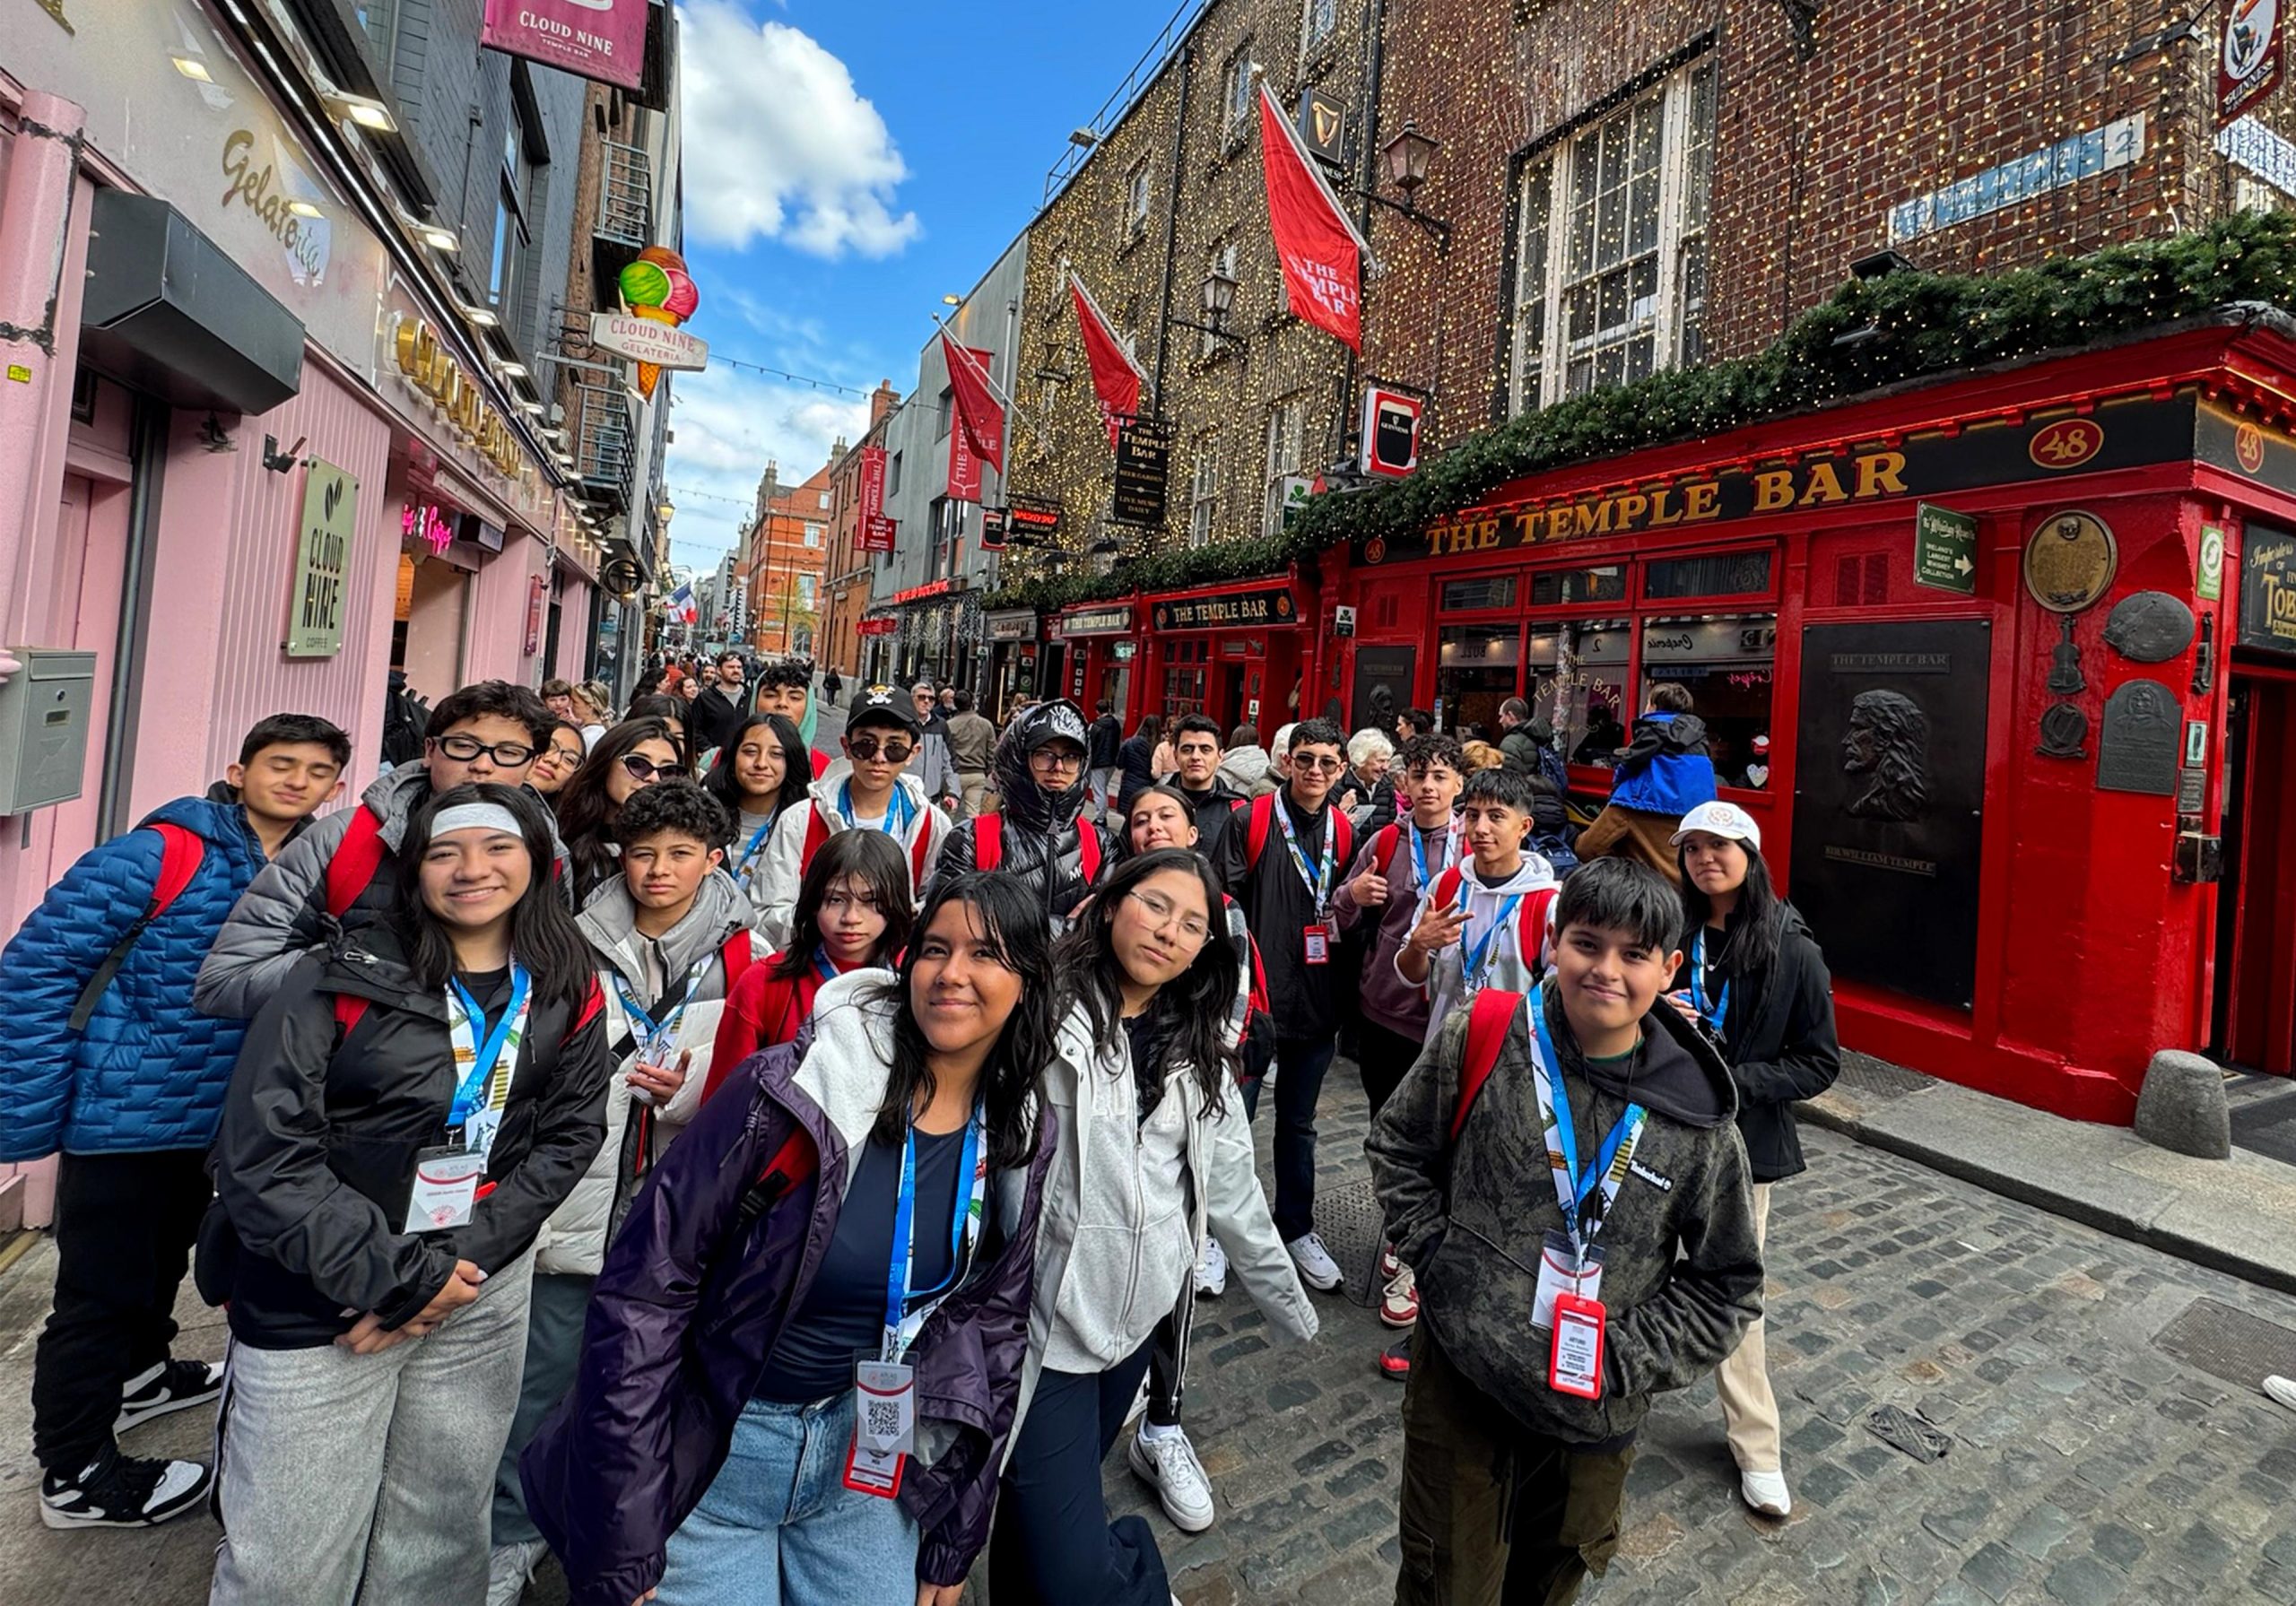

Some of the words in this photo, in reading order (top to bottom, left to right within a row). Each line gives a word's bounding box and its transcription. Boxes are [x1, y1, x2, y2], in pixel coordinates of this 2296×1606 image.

[519, 10, 571, 38] CLOUD
[577, 31, 613, 56] NINE
[542, 39, 571, 54] TEMPLE
[574, 50, 589, 58] BAR
[2115, 131, 2134, 155] 2
[1302, 258, 1338, 280] THE
[611, 319, 657, 339] CLOUD
[662, 330, 695, 352] NINE
[621, 343, 681, 362] GELATERIA
[1121, 431, 1166, 449] TEMPLE
[1137, 428, 1153, 436] THE
[1131, 446, 1157, 460] BAR
[2040, 428, 2089, 461] 48
[2240, 430, 2257, 461] 48
[956, 453, 968, 481] THE
[1426, 518, 1501, 556] THE
[1514, 482, 1722, 544] TEMPLE
[1752, 451, 1909, 512] BAR
[309, 527, 344, 575] CLOUD
[1368, 542, 1382, 560] 48
[302, 572, 340, 629] NINE
[1173, 606, 1194, 623] THE
[1195, 603, 1239, 621] TEMPLE
[1240, 599, 1269, 618] BAR
[1083, 614, 1108, 628] TEMPLE
[1568, 654, 1587, 665] THE
[1832, 655, 1855, 664] THE
[1860, 654, 1911, 664] TEMPLE
[1918, 654, 1947, 664] BAR
[1532, 673, 1587, 704] TEMPLE
[1592, 676, 1622, 709] BAR
[1841, 848, 1889, 863] WILLIAM
[1890, 856, 1933, 872] TEMPLE
